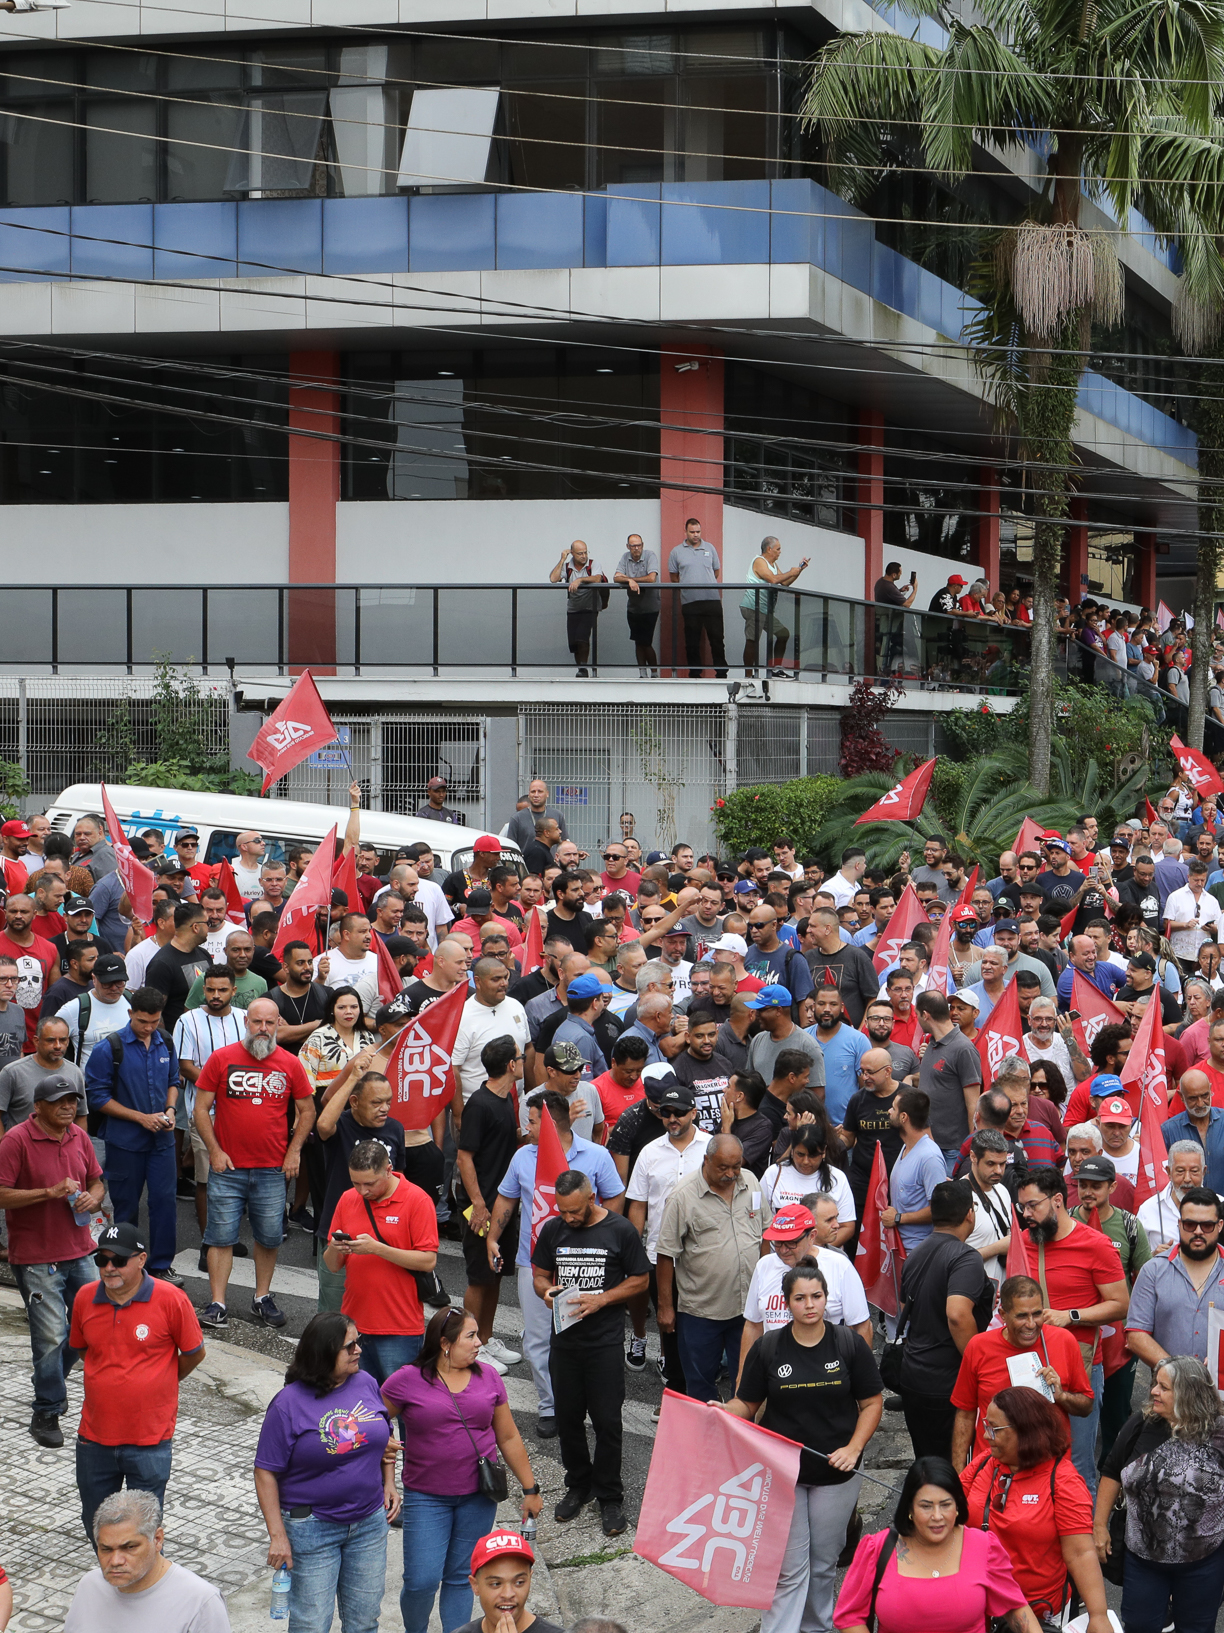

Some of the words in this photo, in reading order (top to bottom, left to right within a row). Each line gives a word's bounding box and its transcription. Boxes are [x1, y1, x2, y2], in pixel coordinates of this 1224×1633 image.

[860, 1119, 876, 1130] REI
[580, 1266, 605, 1277] CUIDA
[577, 1277, 605, 1288] CIDADE
[765, 1311, 782, 1319] SEM
[780, 1380, 842, 1389] PORSCHE
[485, 1535, 519, 1549] CUT
